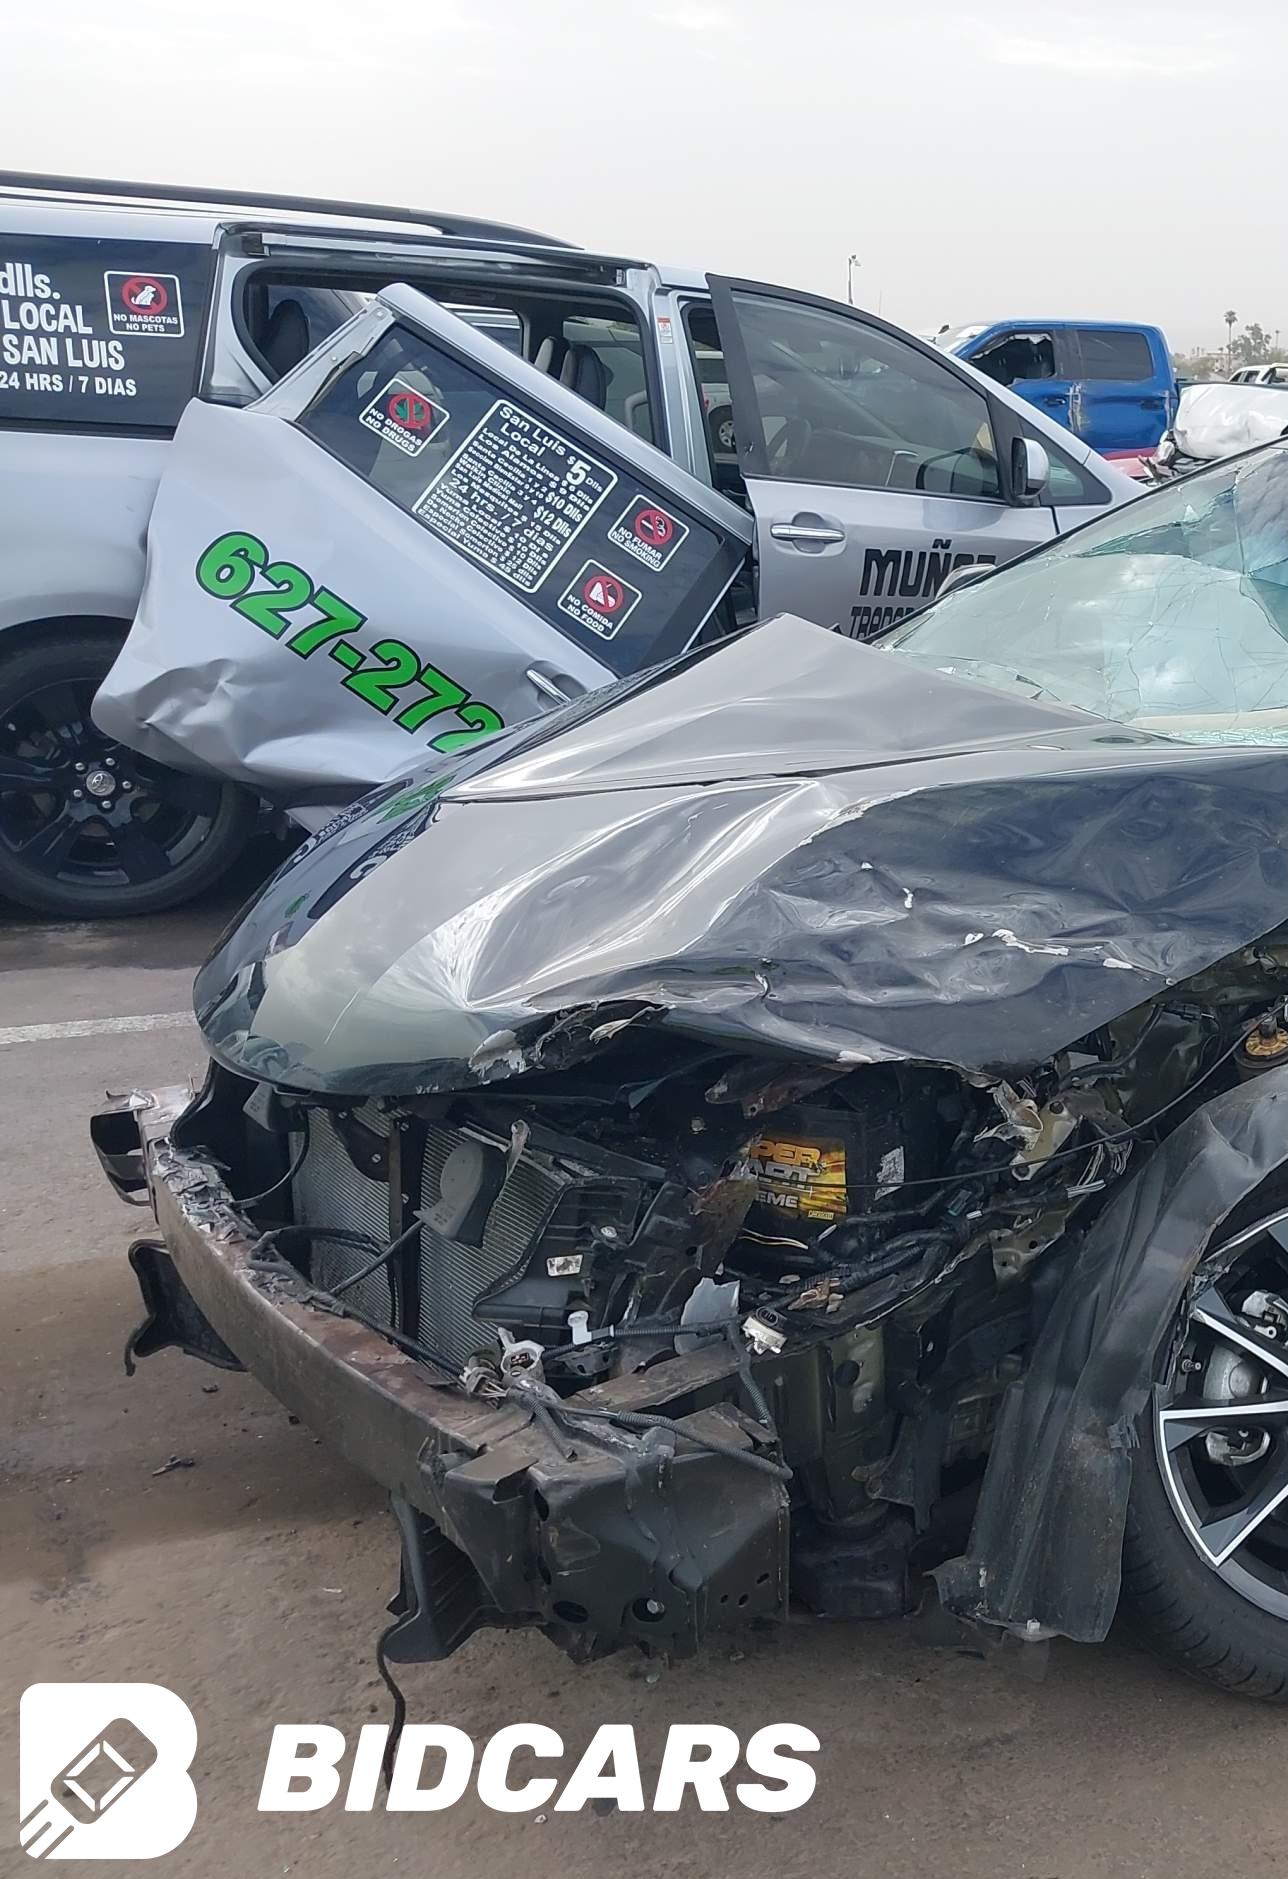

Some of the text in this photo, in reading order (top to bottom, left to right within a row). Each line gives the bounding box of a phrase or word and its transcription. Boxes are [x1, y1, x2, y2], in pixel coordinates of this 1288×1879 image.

[0, 262, 61, 300] dlls.
[2, 299, 93, 334] LOCAL
[113, 313, 178, 325] NO MASCOTAS
[125, 323, 165, 333] NO PETS
[2, 334, 125, 371] SAN LUIS
[0, 372, 20, 390] 24
[25, 373, 64, 392] HRS
[78, 375, 89, 393] 7
[94, 376, 137, 396] DIAS
[365, 415, 415, 452] NO DRUGS
[369, 408, 422, 446] NO DROGAS
[499, 406, 566, 456] San Luis
[500, 422, 546, 456] Local
[584, 476, 602, 492] Dlls
[447, 477, 469, 493] 24
[470, 491, 498, 515] hrs.
[511, 517, 522, 527] 7
[523, 528, 554, 551] dias
[533, 505, 572, 538] $12 Dlls
[545, 491, 583, 522] $10 Dlls
[612, 531, 661, 568] NO SMOKING
[618, 526, 662, 560] NO FUMAR
[859, 538, 996, 597] MUÑ
[567, 594, 613, 629] NO COMIDA
[567, 604, 604, 633] NO FOOD
[195, 531, 505, 753] 627-272
